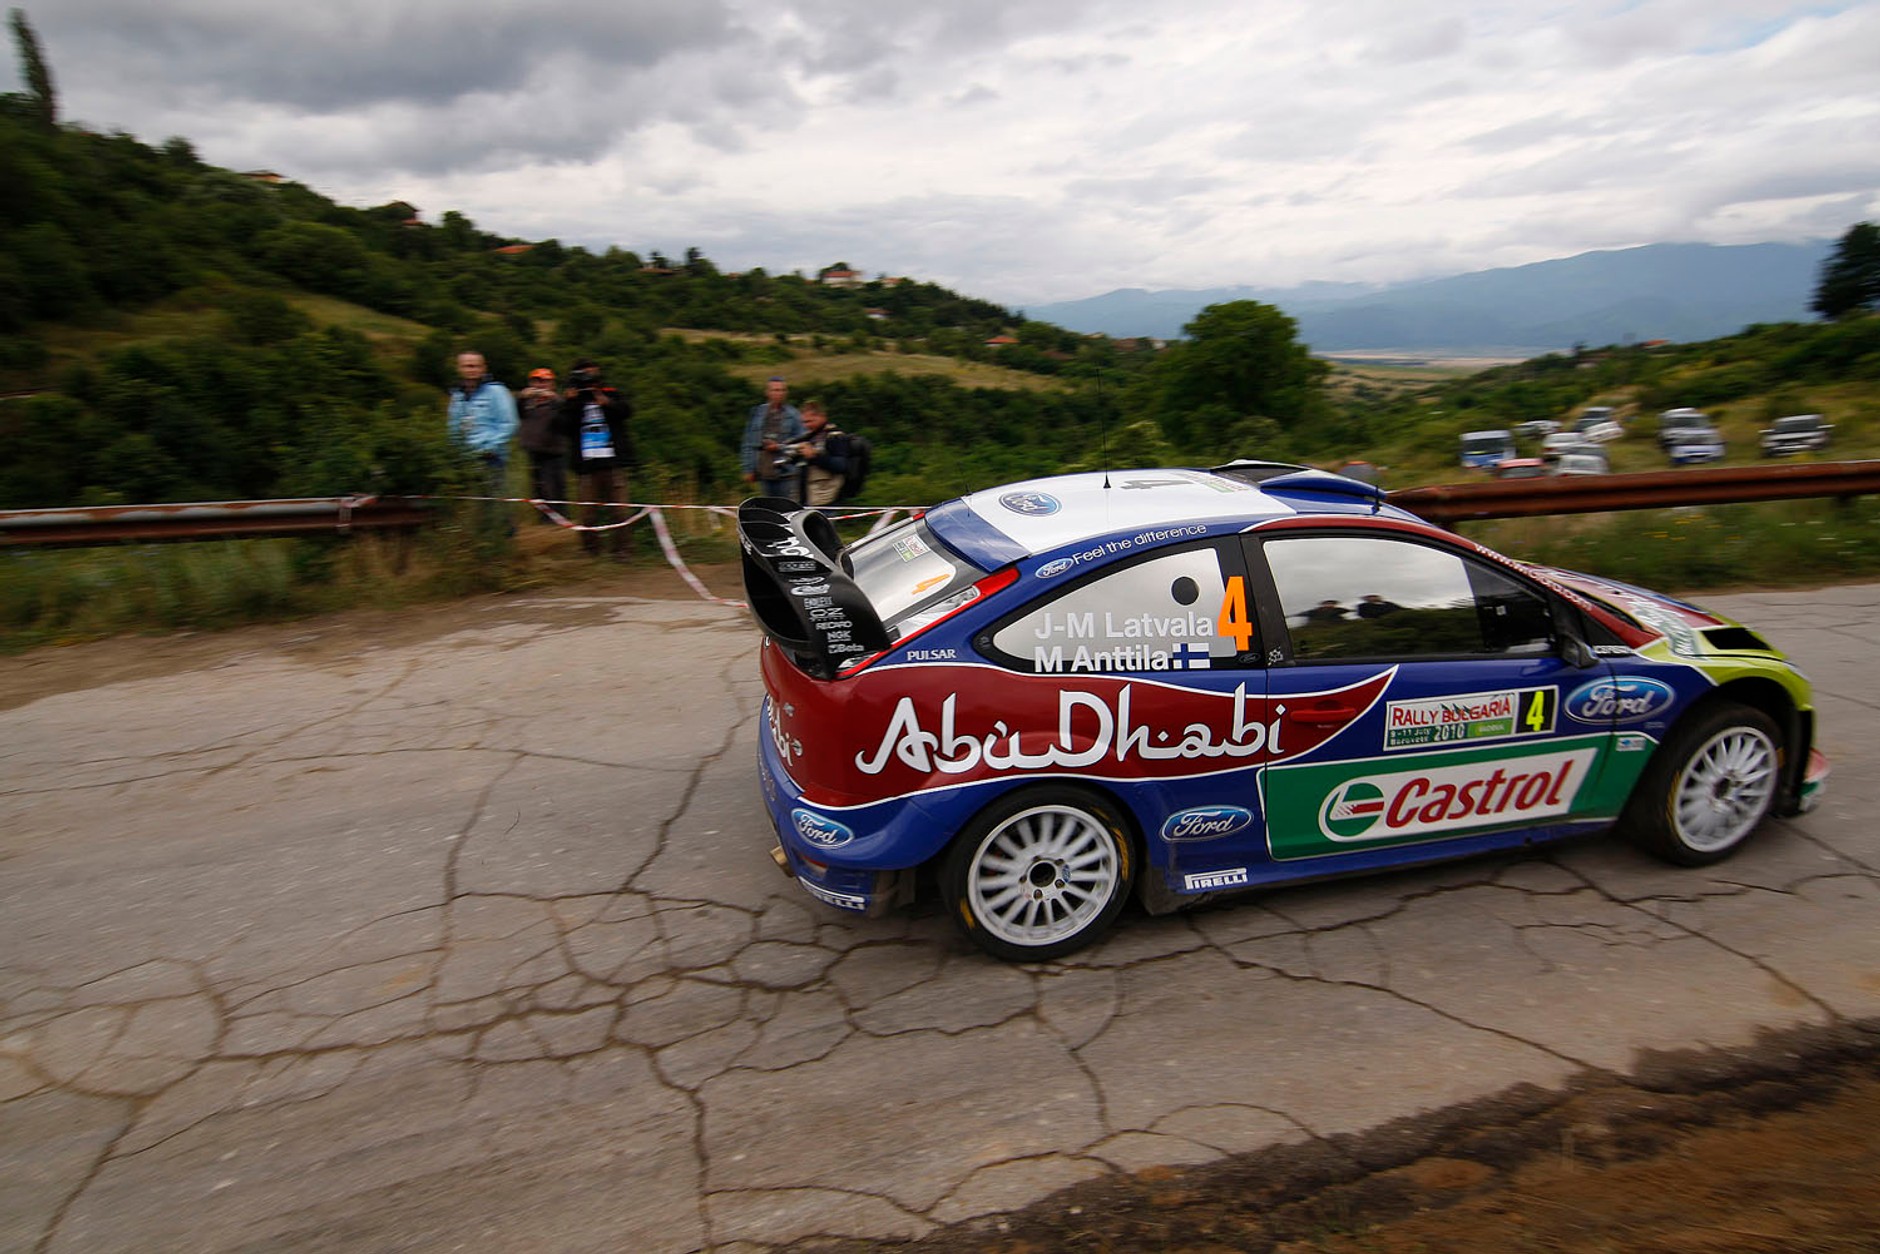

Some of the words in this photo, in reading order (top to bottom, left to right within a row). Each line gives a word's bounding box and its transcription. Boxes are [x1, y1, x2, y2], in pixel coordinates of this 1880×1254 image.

[1042, 561, 1069, 577] Ford
[1072, 545, 1105, 565] Feel
[1106, 540, 1131, 554] the
[1134, 523, 1207, 546] difference
[1035, 612, 1094, 639] J-M
[1106, 611, 1213, 638] Latvala
[1217, 575, 1253, 651] 4
[827, 631, 851, 640] NGK
[840, 643, 864, 653] Beta
[906, 648, 957, 661] PULSAR
[1035, 645, 1063, 673] M
[1071, 643, 1169, 672] Anttila
[1392, 707, 1438, 727] RALLY
[1442, 697, 1511, 723] BULGARIA
[1525, 690, 1544, 731] 4
[1582, 684, 1655, 717] Ford
[855, 692, 1053, 775] Abu
[1053, 681, 1287, 767] Dhabi
[1434, 722, 1465, 741] 2010
[1386, 759, 1574, 828] Castrol
[799, 814, 839, 844] Ford
[1173, 810, 1236, 837] Ford
[1184, 867, 1248, 890] PIRELLI
